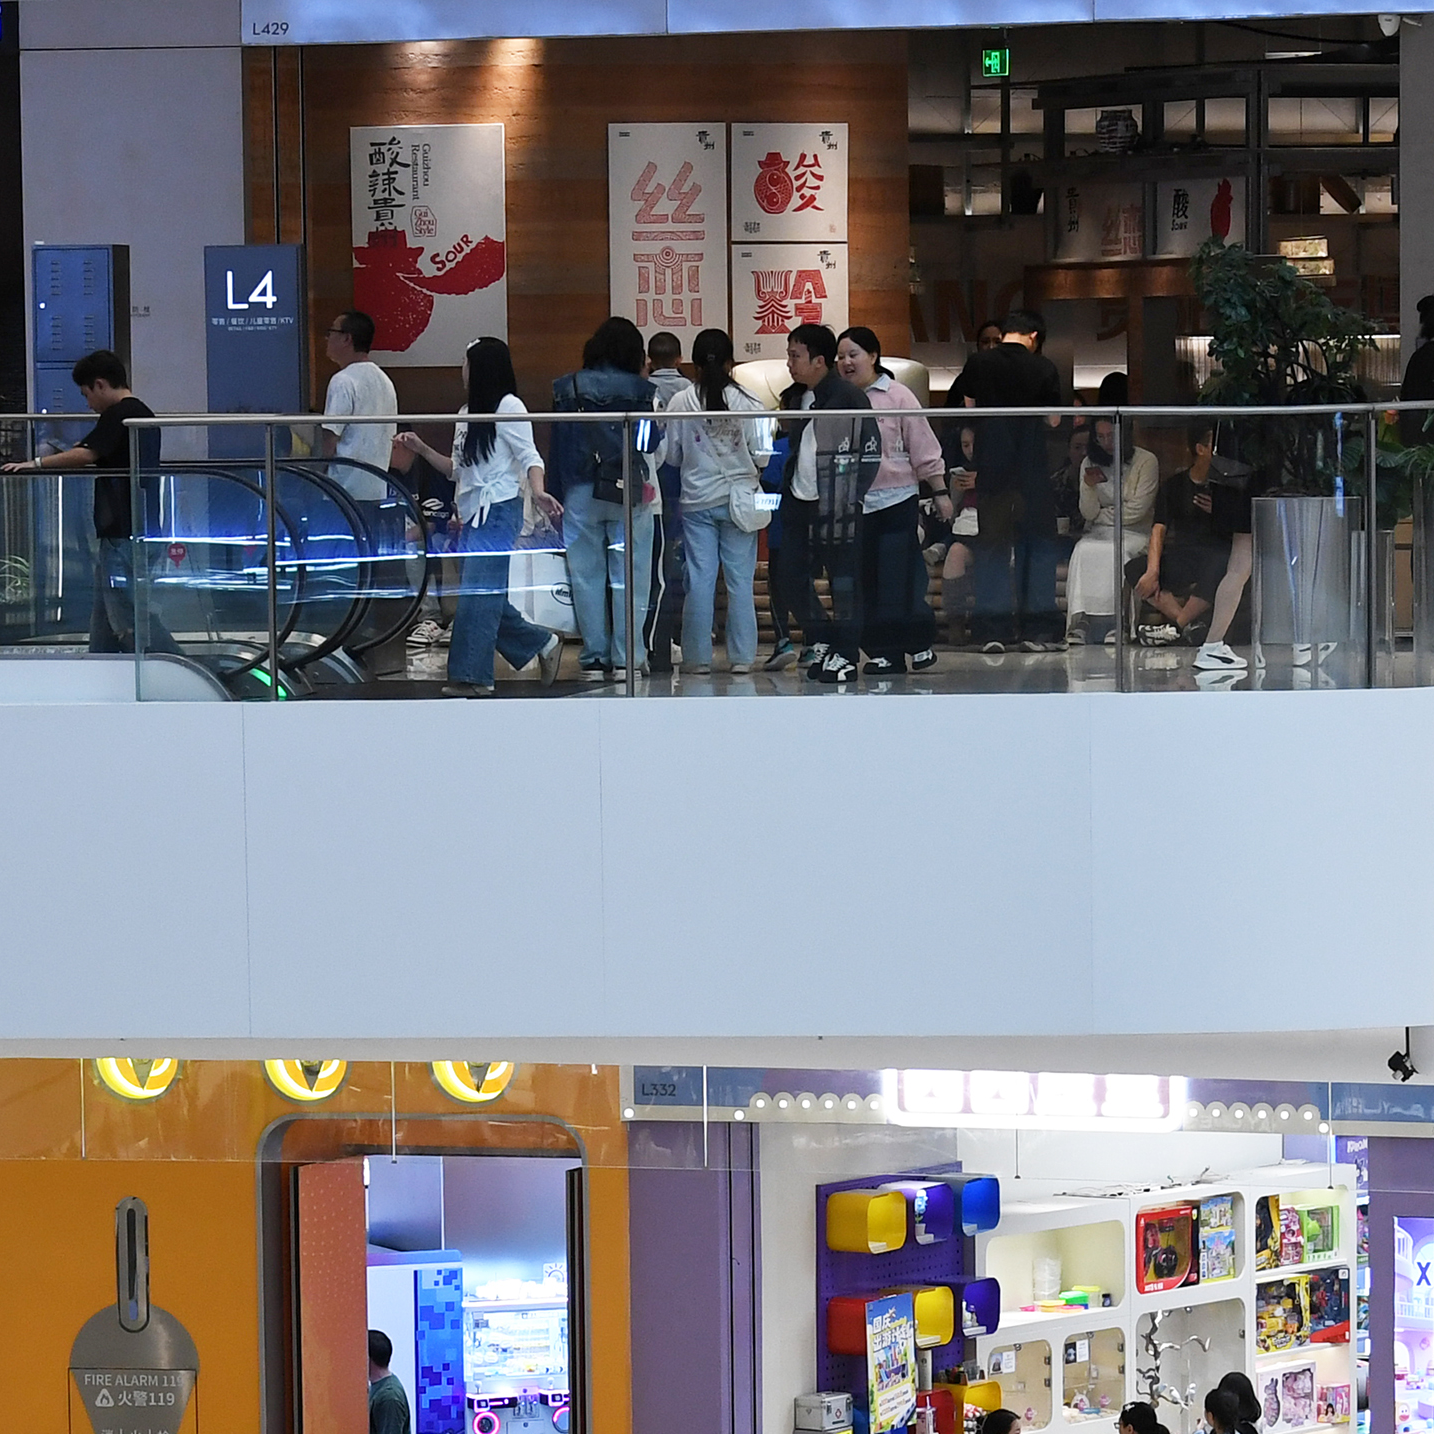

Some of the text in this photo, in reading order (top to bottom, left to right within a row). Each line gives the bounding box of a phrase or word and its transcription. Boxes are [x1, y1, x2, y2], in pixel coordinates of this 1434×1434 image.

[252, 22, 289, 36] L429
[422, 143, 432, 187] Guizhou
[411, 144, 421, 201] Restaurant
[414, 209, 429, 218] Gui
[414, 218, 435, 226] Zhou
[414, 226, 435, 236] Style
[226, 270, 278, 310] L4
[642, 1083, 676, 1097] L332
[84, 1374, 183, 1387] FIRE ALARM 119
[118, 1390, 175, 1407] 火警119
